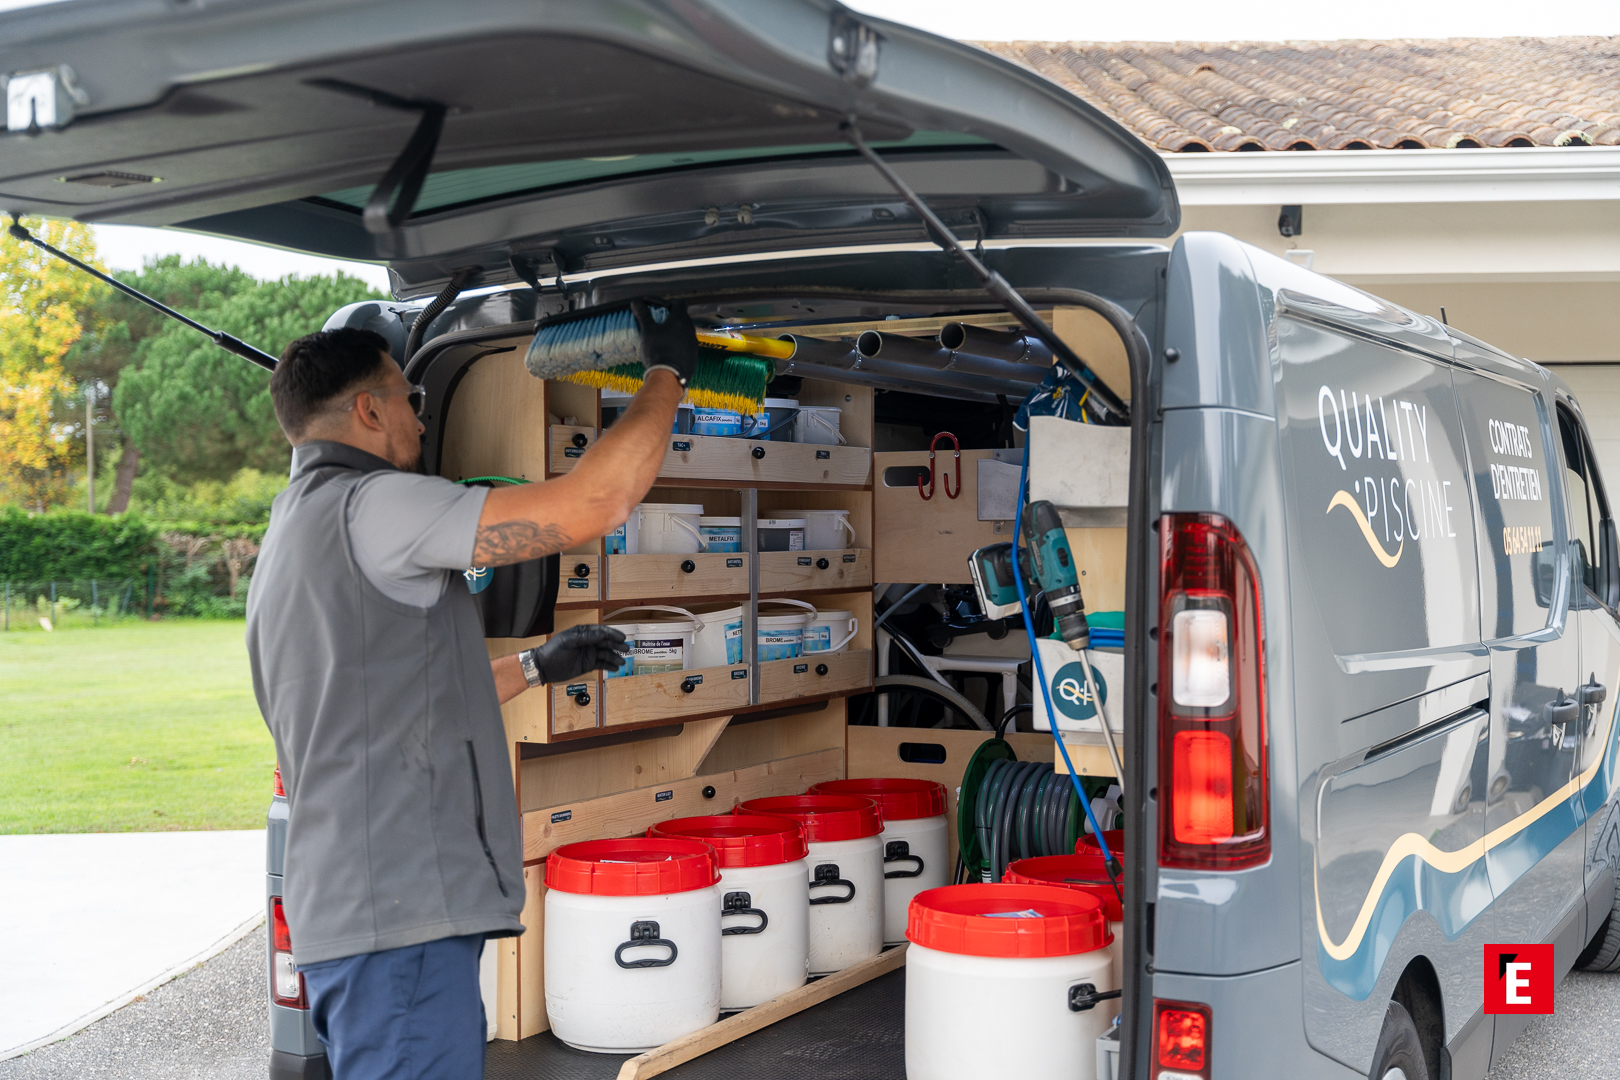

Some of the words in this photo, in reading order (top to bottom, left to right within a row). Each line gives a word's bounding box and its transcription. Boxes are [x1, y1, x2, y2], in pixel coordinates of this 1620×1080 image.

[1318, 385, 1430, 470] QUALITY
[1488, 418, 1532, 459] CONTRATS
[1490, 463, 1542, 501] D'ENTRETIEN
[1364, 476, 1456, 542] PISCINE
[1503, 526, 1512, 556] 05
[1512, 526, 1521, 555] 64
[1527, 526, 1536, 553] 11
[1535, 525, 1543, 552] 11
